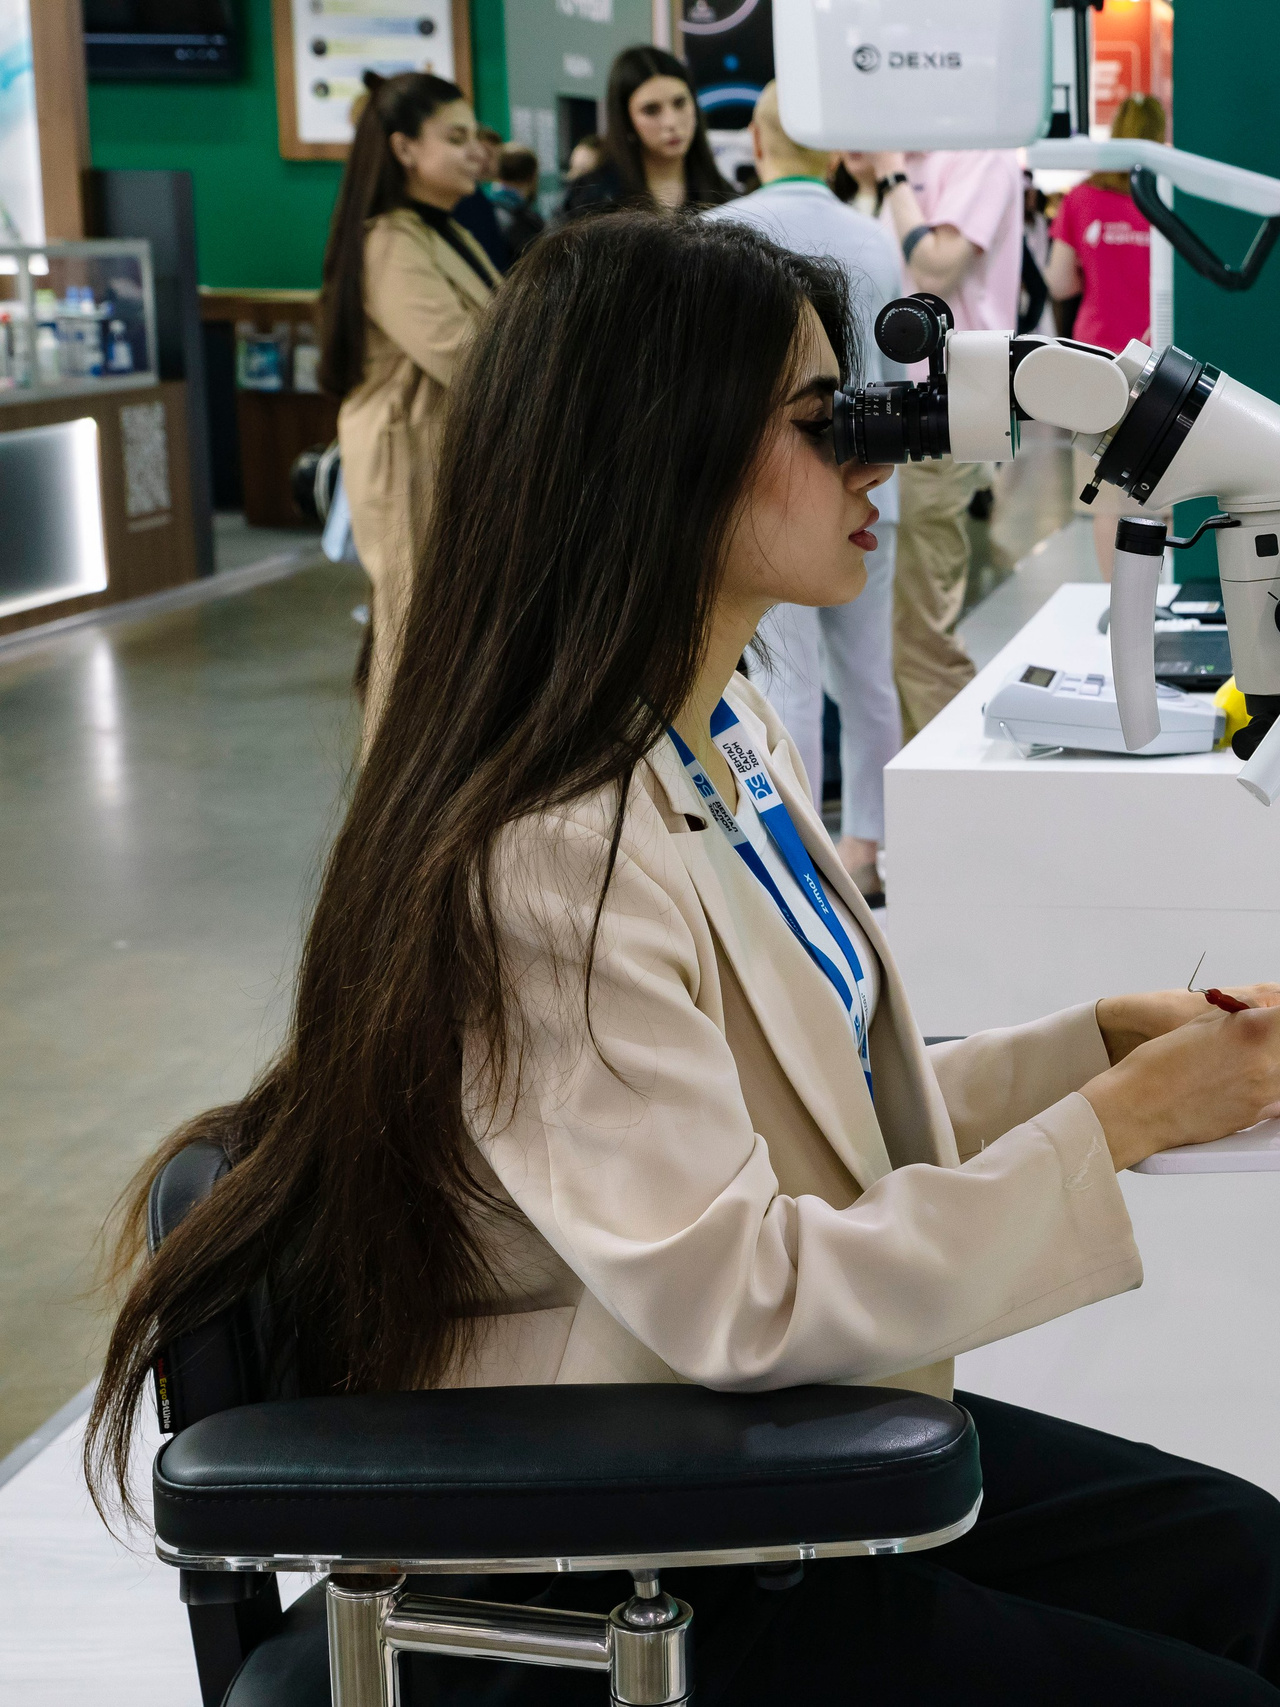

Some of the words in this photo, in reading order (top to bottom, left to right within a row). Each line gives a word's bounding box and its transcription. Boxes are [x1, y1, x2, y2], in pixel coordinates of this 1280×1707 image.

[888, 51, 962, 70] DEXIS
[722, 743, 747, 773] ДЕНТАЛ
[731, 741, 752, 771] САЛОН
[746, 750, 759, 767] 2026
[715, 801, 739, 832] ДЕНТАЛ
[803, 873, 830, 914] zumax
